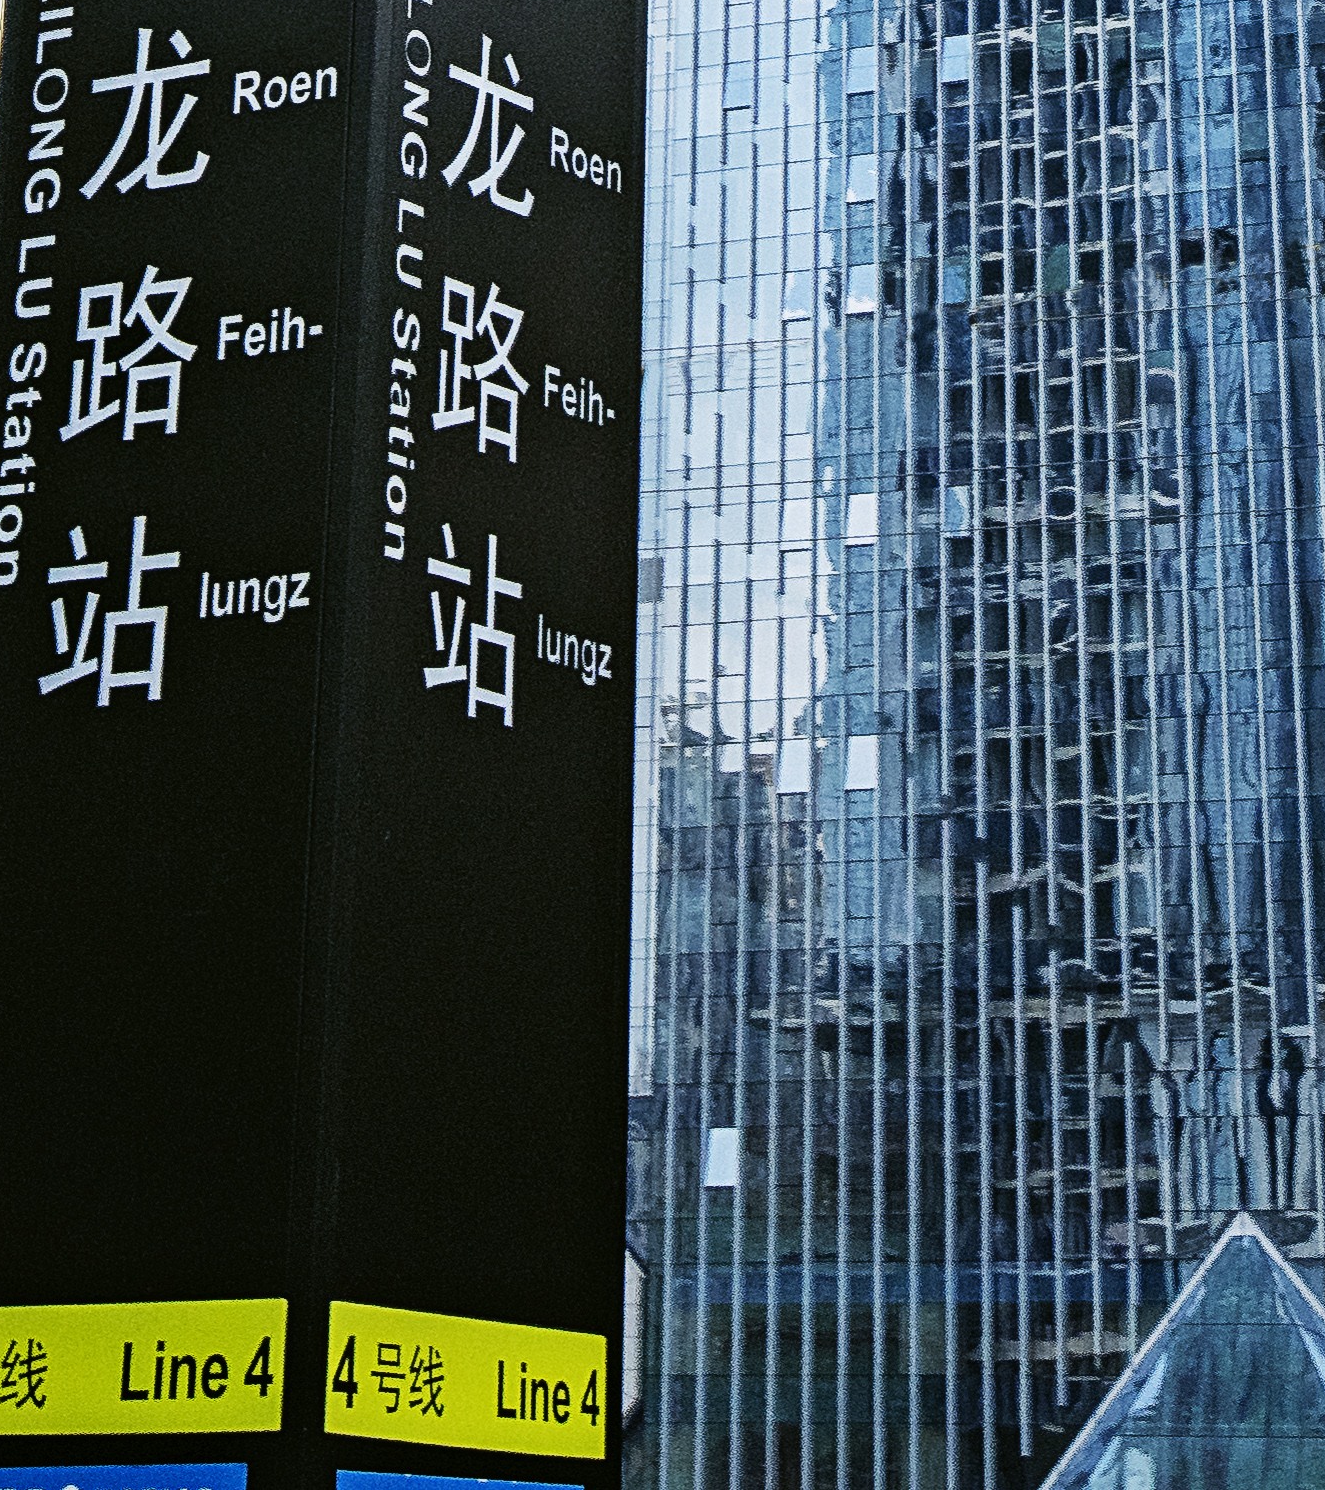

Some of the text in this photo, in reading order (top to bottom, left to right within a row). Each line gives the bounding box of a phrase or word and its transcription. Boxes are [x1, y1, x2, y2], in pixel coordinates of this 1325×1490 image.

[231, 62, 339, 115] Roen
[549, 126, 623, 194] Roen
[13, 234, 57, 320] LU
[392, 197, 426, 289] LU
[216, 307, 325, 361] Feih-
[542, 363, 616, 428] Feih-
[382, 311, 422, 561] Station
[198, 570, 312, 623] lungz
[536, 613, 614, 686] lungz
[120, 1339, 230, 1403] Line
[243, 1334, 275, 1399] 4
[331, 1335, 601, 1428] 4号线 Line 4
